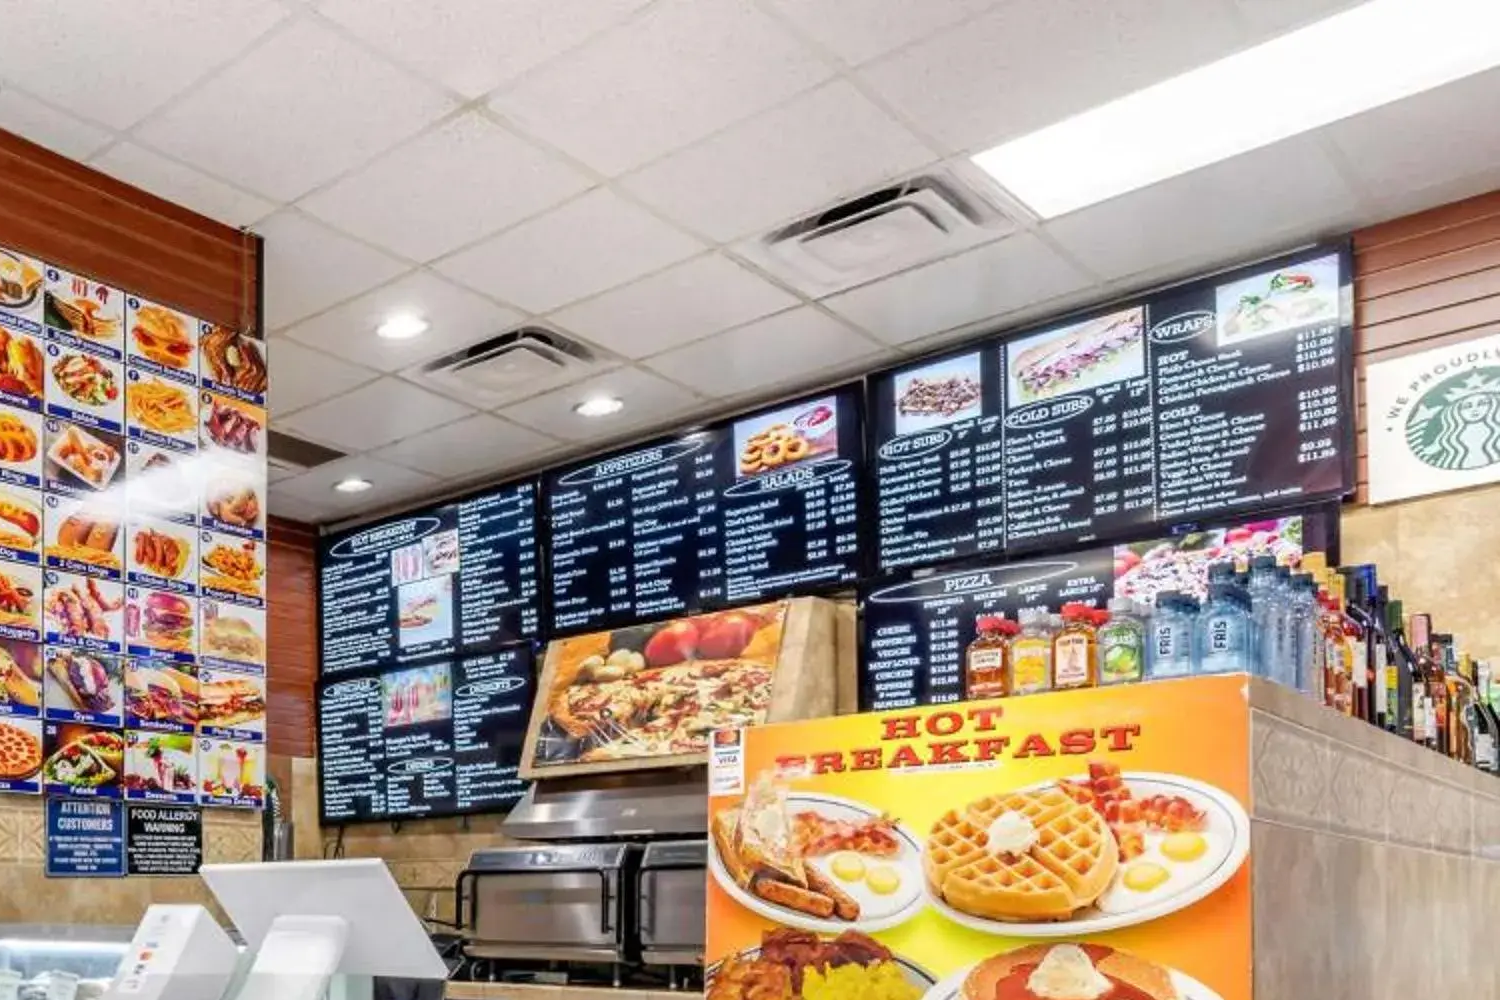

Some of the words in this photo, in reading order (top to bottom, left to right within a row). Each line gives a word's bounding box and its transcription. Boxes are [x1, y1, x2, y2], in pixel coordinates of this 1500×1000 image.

[1154, 314, 1214, 340] WRAPS
[1009, 407, 1048, 424] COLD
[1051, 400, 1088, 417] SUBS
[1388, 396, 1409, 419] WE
[595, 449, 663, 477] APPETIZERS
[760, 467, 815, 490] SALADS
[0, 548, 17, 559] Dog
[944, 573, 993, 592] PIZZA
[881, 706, 1004, 741] HOT
[61, 802, 110, 815] ATTENTION
[132, 809, 156, 819] FOOD
[158, 810, 198, 821] ALLERGY
[58, 818, 113, 831] CUSTOMERS
[144, 822, 185, 833] WARNING
